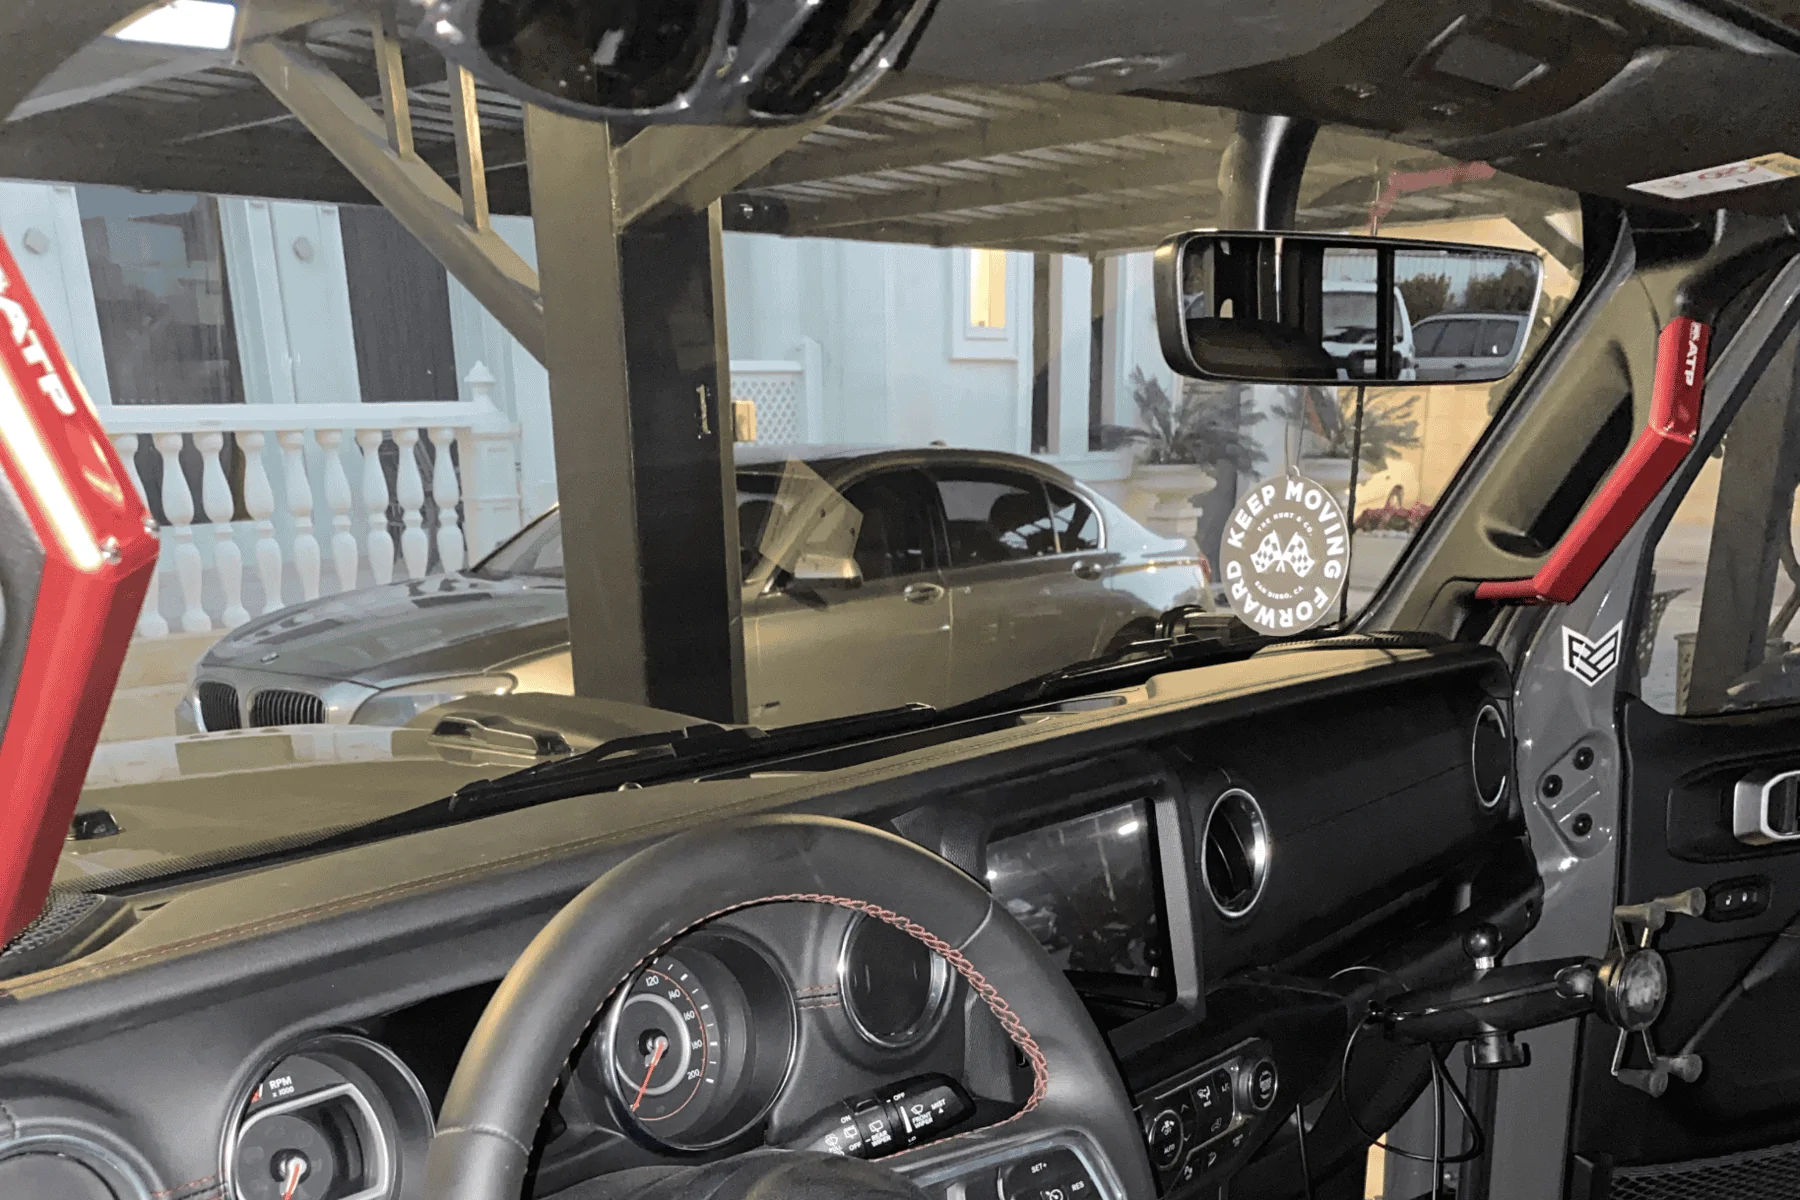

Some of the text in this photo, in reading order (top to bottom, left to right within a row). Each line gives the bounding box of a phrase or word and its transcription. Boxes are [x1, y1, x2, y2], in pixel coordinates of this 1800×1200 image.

[1227, 480, 1345, 579] KEEP MOVING
[1226, 560, 1329, 628] FORWARD
[646, 976, 659, 986] 120
[668, 989, 681, 1000] 140
[684, 1011, 695, 1021] 160
[692, 1040, 702, 1050] 180
[687, 1069, 700, 1080] 200
[269, 1075, 292, 1090] RPM
[893, 1092, 905, 1101] OFF
[931, 1099, 946, 1110] MIST
[841, 1115, 851, 1124] ON
[912, 1111, 932, 1123] FRONT
[914, 1117, 934, 1129] WIPER
[849, 1141, 861, 1151] OFF
[1071, 1181, 1084, 1191] RES
